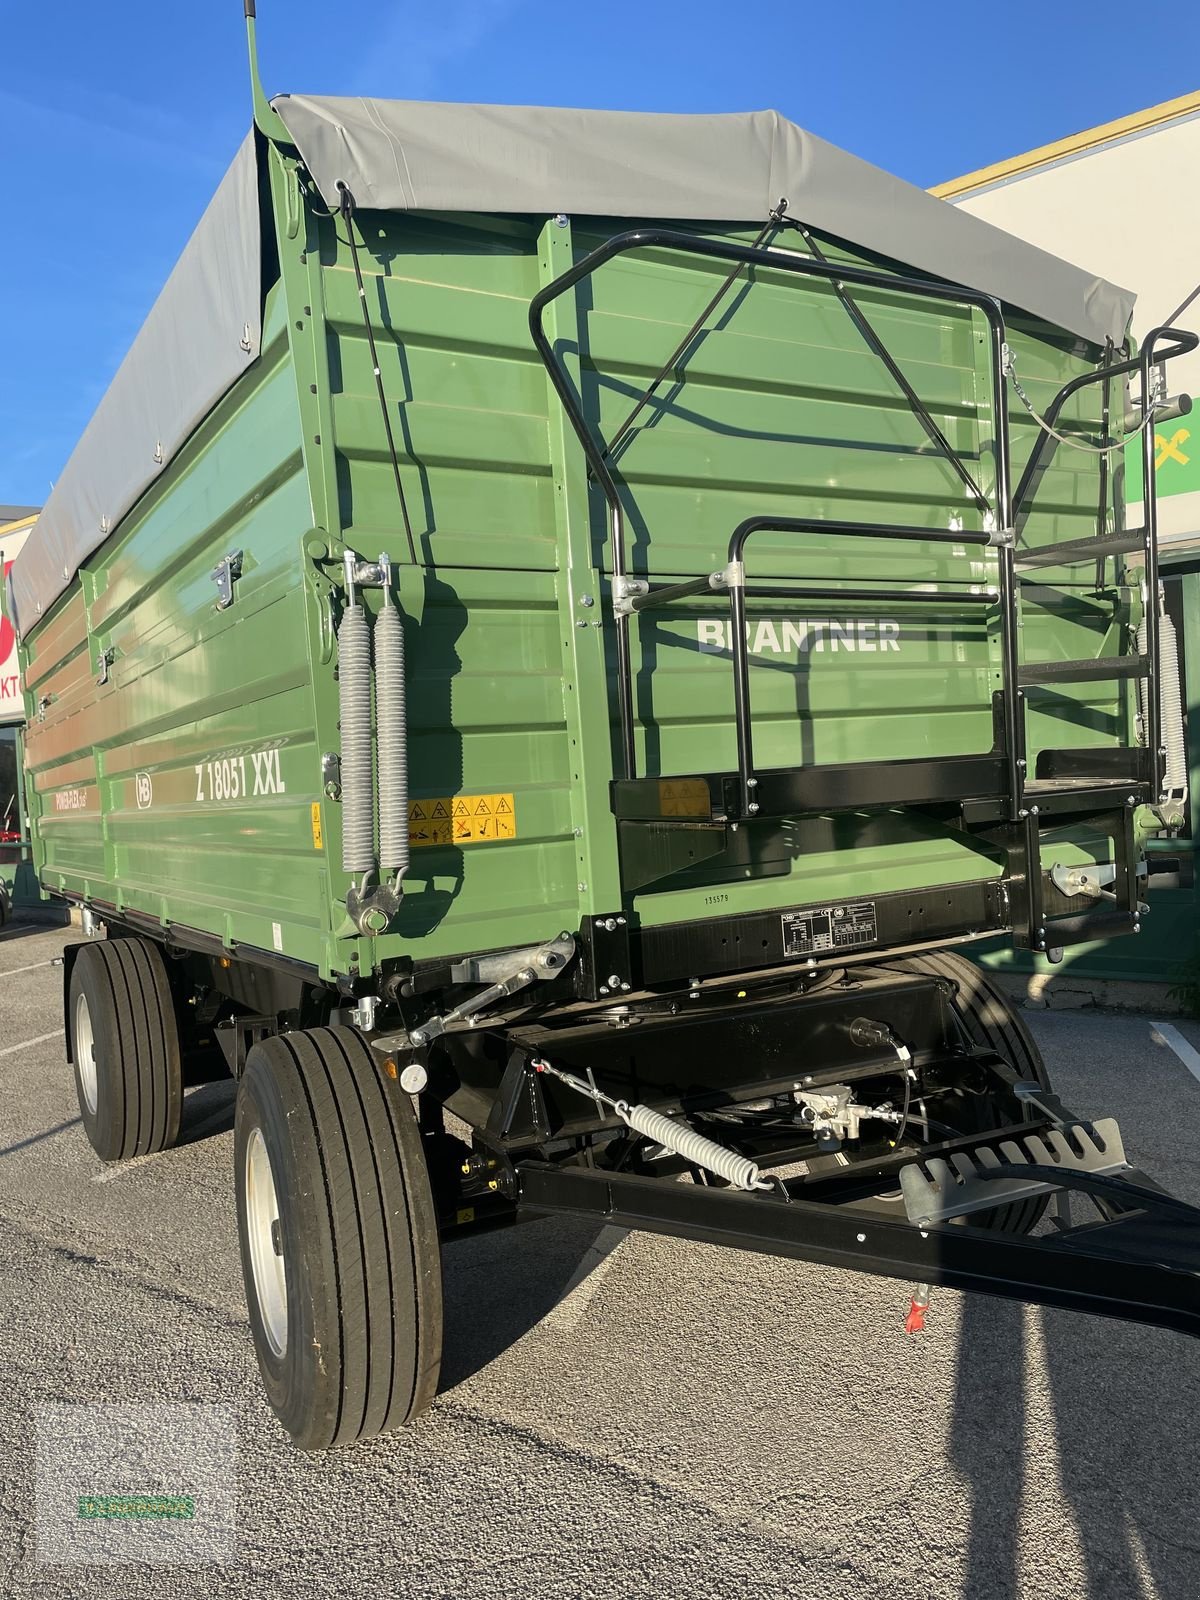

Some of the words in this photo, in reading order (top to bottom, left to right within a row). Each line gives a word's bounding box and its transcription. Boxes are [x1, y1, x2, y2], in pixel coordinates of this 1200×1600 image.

[194, 764, 204, 801] Z
[207, 756, 246, 800] 18051
[251, 749, 286, 796] XXL
[704, 894, 729, 905] 135579
